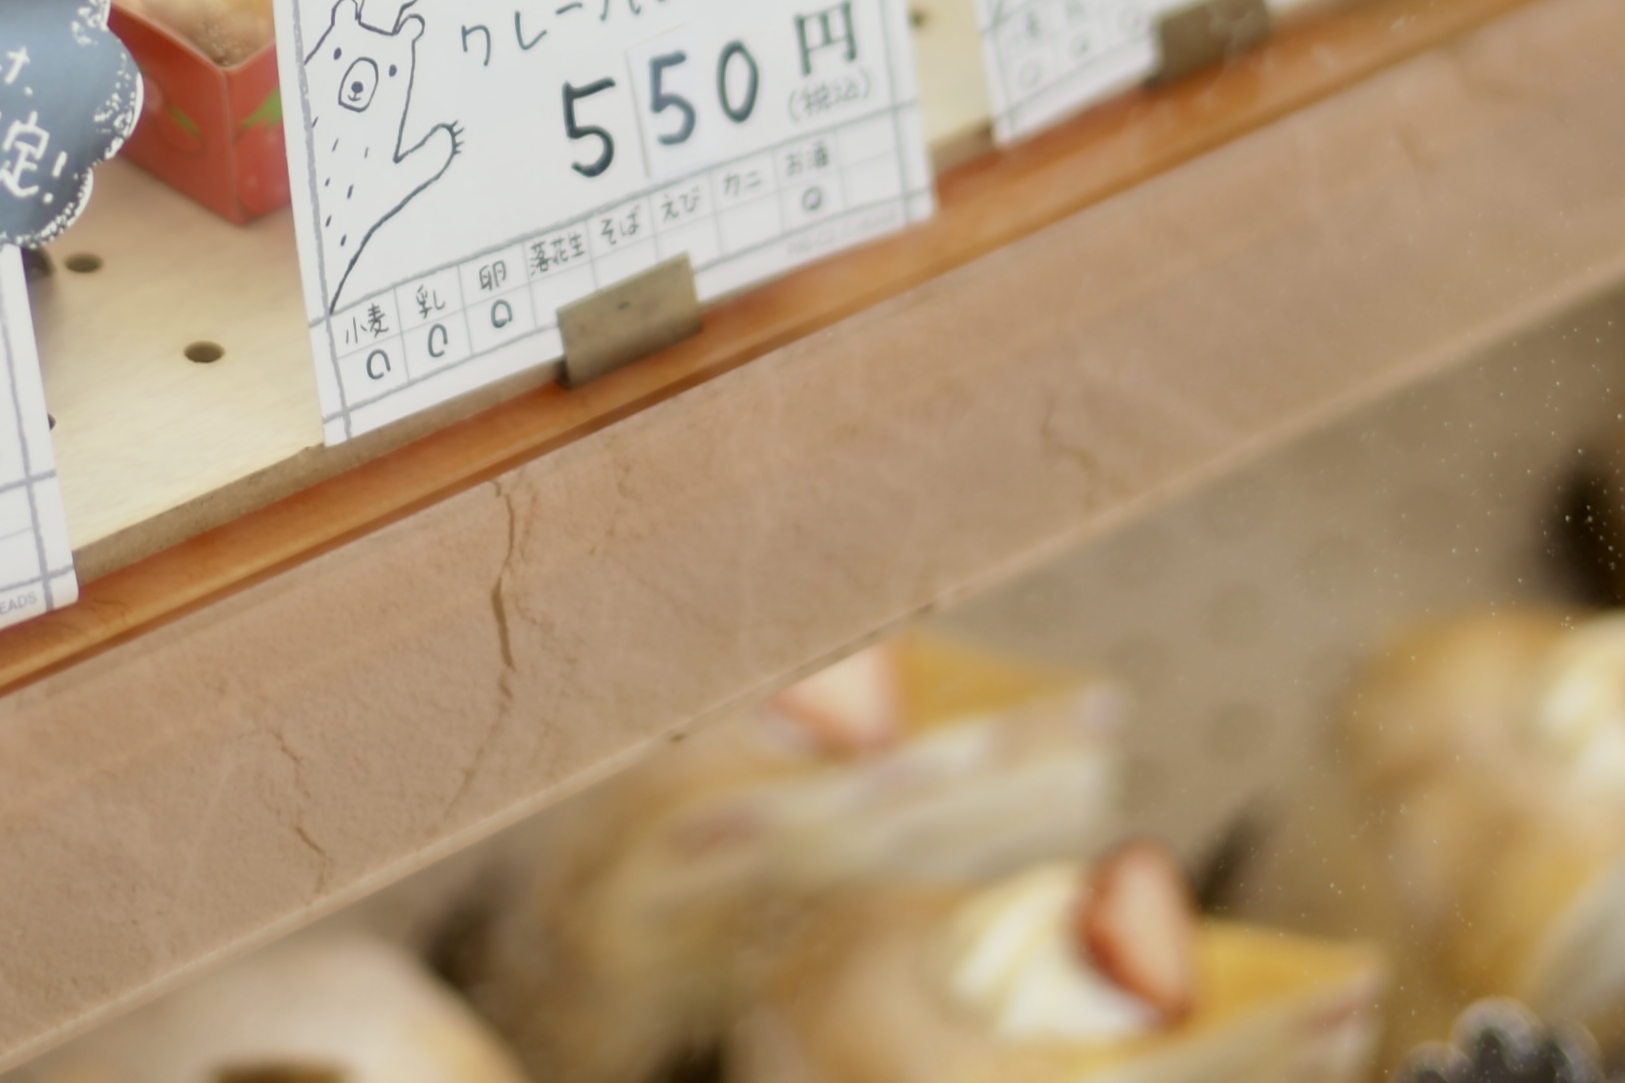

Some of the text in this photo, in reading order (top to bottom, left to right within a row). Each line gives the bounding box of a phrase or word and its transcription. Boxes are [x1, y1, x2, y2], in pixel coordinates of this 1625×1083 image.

[563, 39, 760, 178] 550
[787, 66, 872, 123] (税込)
[345, 303, 390, 345] 小麦
[416, 284, 446, 320] 乳
[479, 260, 507, 292] 卵
[530, 231, 587, 276] 落花生
[600, 204, 642, 246] そば
[661, 187, 701, 223] えび
[723, 171, 763, 197] カニ
